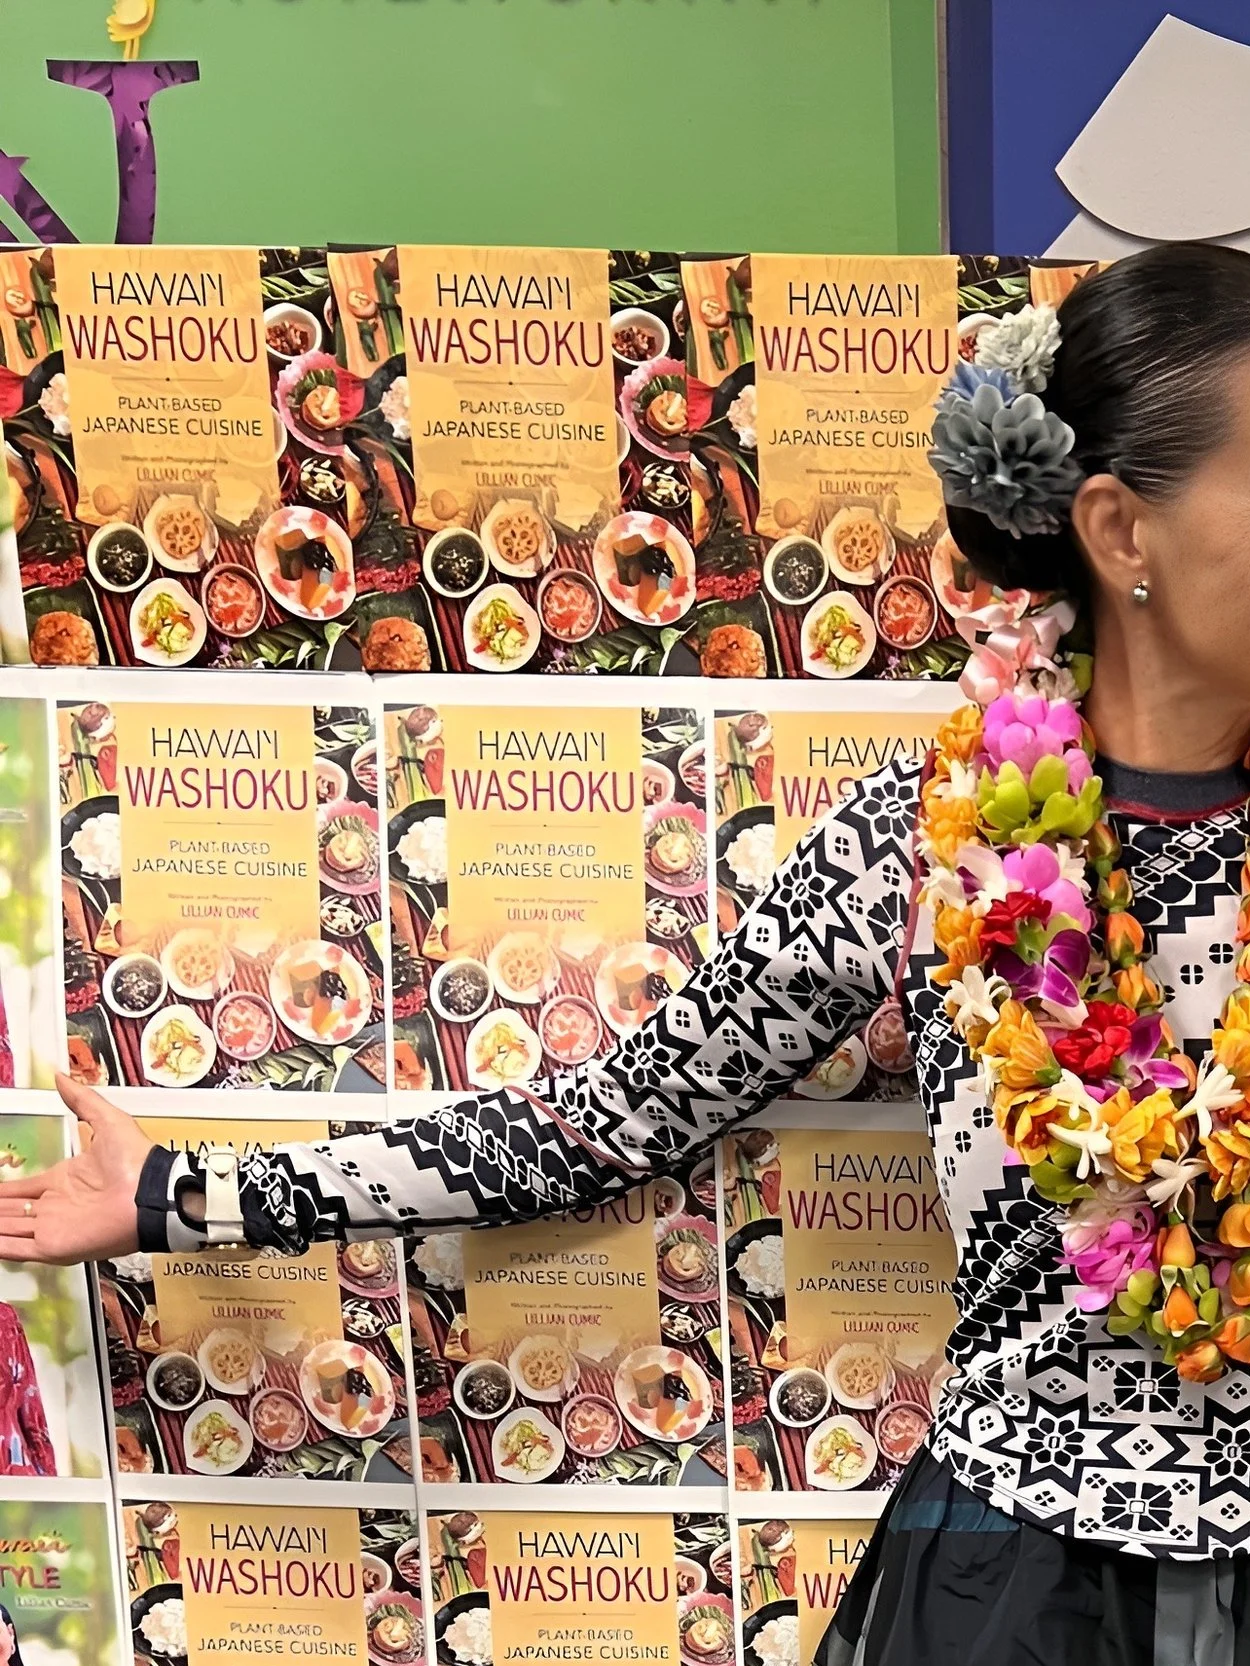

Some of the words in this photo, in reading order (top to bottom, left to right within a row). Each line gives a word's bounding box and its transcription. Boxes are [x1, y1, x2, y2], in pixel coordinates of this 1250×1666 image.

[66, 314, 258, 364] WASHOKU
[410, 316, 604, 368] WASHOKU
[760, 326, 950, 374] WASHOKU
[82, 416, 180, 436] JAPANESE
[186, 418, 262, 436] CUISINE
[422, 420, 520, 440] JAPANESE
[528, 422, 606, 442] CUISINE
[768, 430, 866, 448] JAPANESE
[124, 766, 308, 812] WASHOKU
[452, 768, 634, 814] WASHOKU
[132, 858, 226, 876] JAPANESE
[234, 860, 306, 878] CUISINE
[458, 862, 552, 878] JAPANESE
[560, 864, 634, 880] CUISINE
[786, 1190, 952, 1232] WASHOK
[164, 1262, 252, 1278] JAPANESE
[256, 1264, 328, 1282] CUISINE
[474, 1268, 568, 1286] JAPANESE
[574, 1270, 648, 1288] CUISINE
[796, 1278, 888, 1294] JAPANESE
[186, 1556, 356, 1598] WASHOKU
[492, 1566, 668, 1606] WASHOKU
[198, 1638, 284, 1654] JAPANESE
[290, 1640, 356, 1656] CUISINE
[504, 1646, 592, 1660] JAPANESE
[600, 1646, 668, 1660] CUISINE
